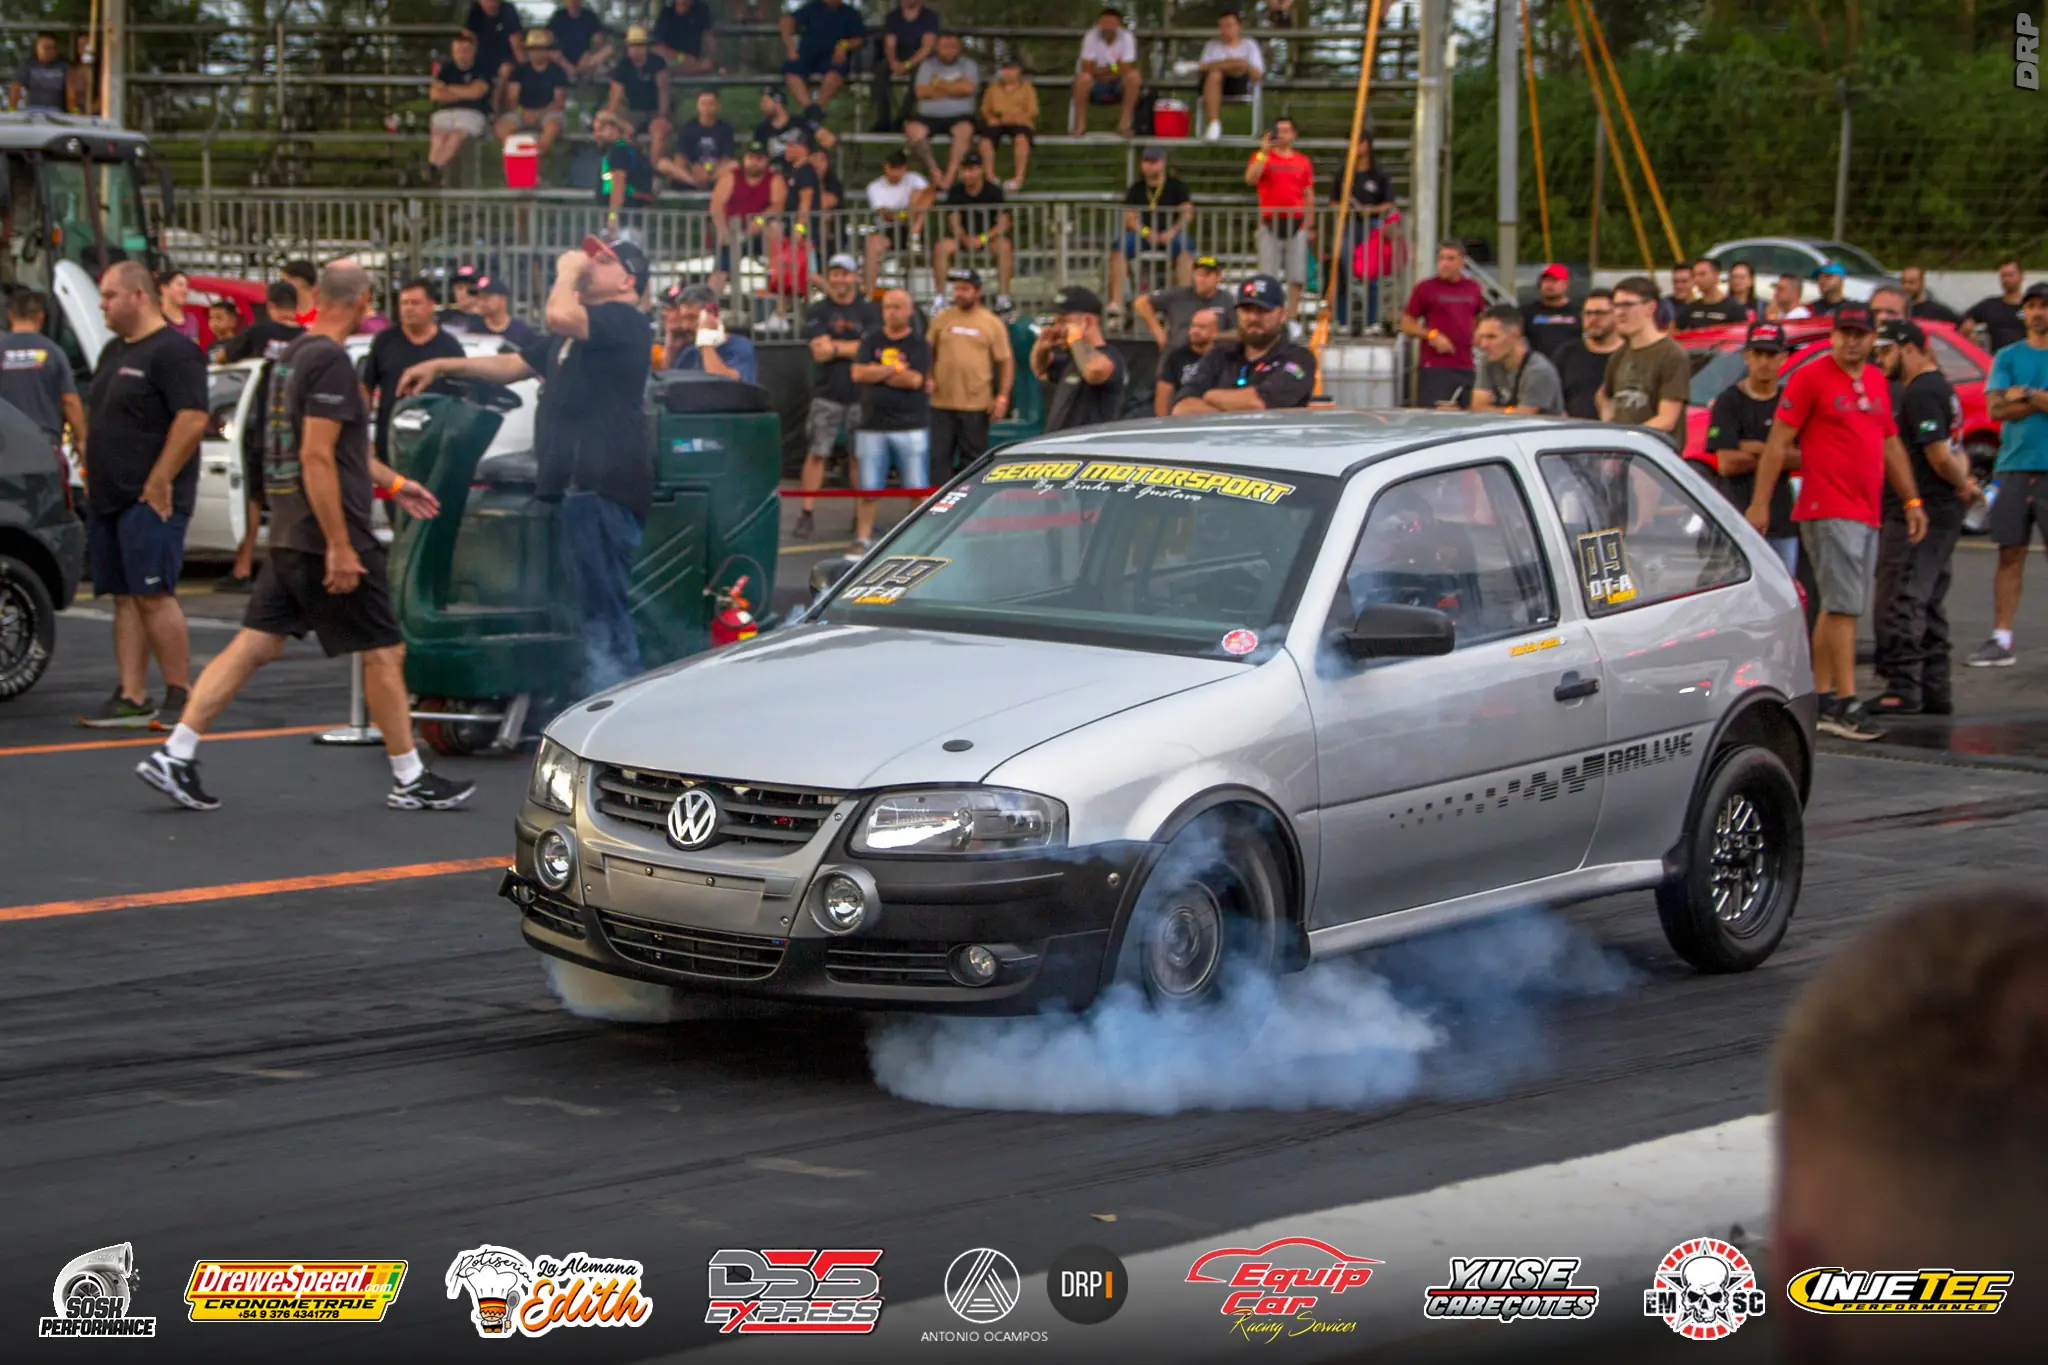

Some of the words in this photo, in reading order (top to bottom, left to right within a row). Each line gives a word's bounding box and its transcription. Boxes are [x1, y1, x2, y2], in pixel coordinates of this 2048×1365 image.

[985, 463, 1079, 481] SERRO
[1080, 463, 1291, 503] MOTORSPORT
[1578, 531, 1628, 588] 09
[1607, 731, 1693, 776] RALLYE
